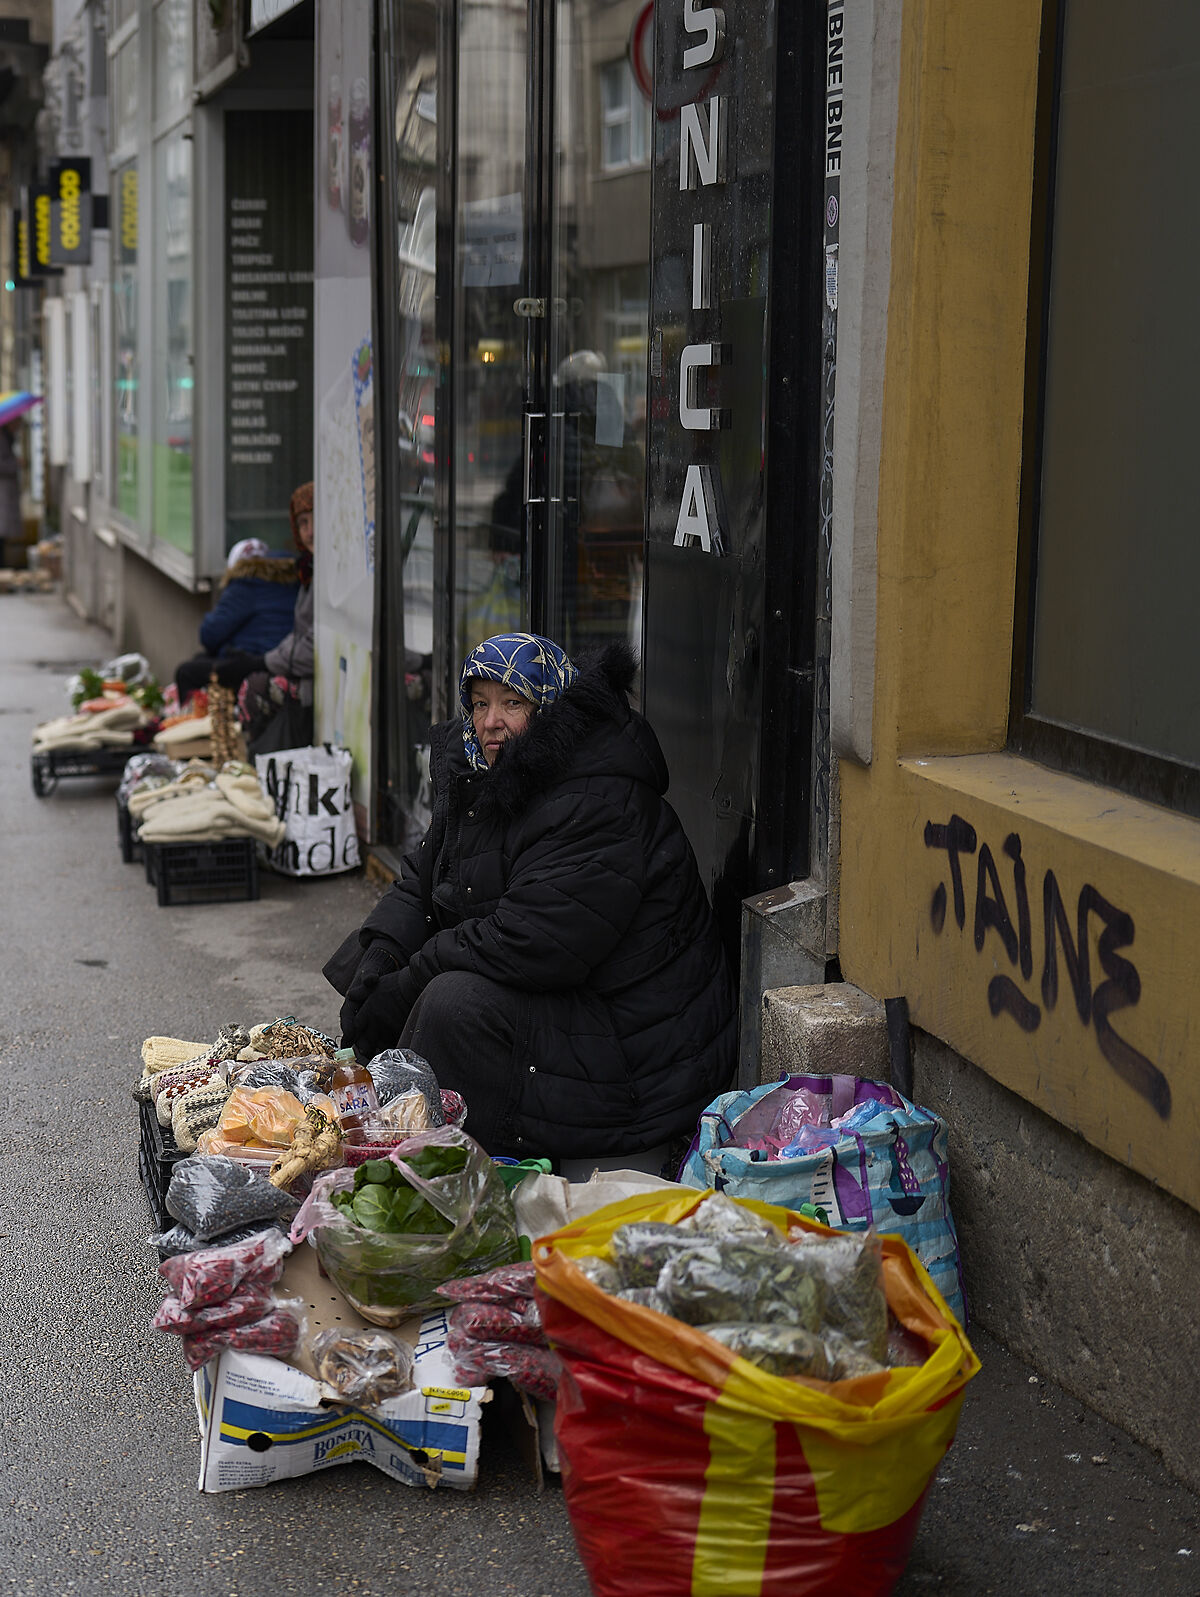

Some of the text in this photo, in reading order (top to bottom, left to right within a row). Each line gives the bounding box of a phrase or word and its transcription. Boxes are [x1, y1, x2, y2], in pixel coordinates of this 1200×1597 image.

[828, 12, 844, 88] BNE
[826, 100, 843, 174] BNE
[340, 1098, 369, 1113] SARA
[313, 1429, 376, 1460] BONITA
